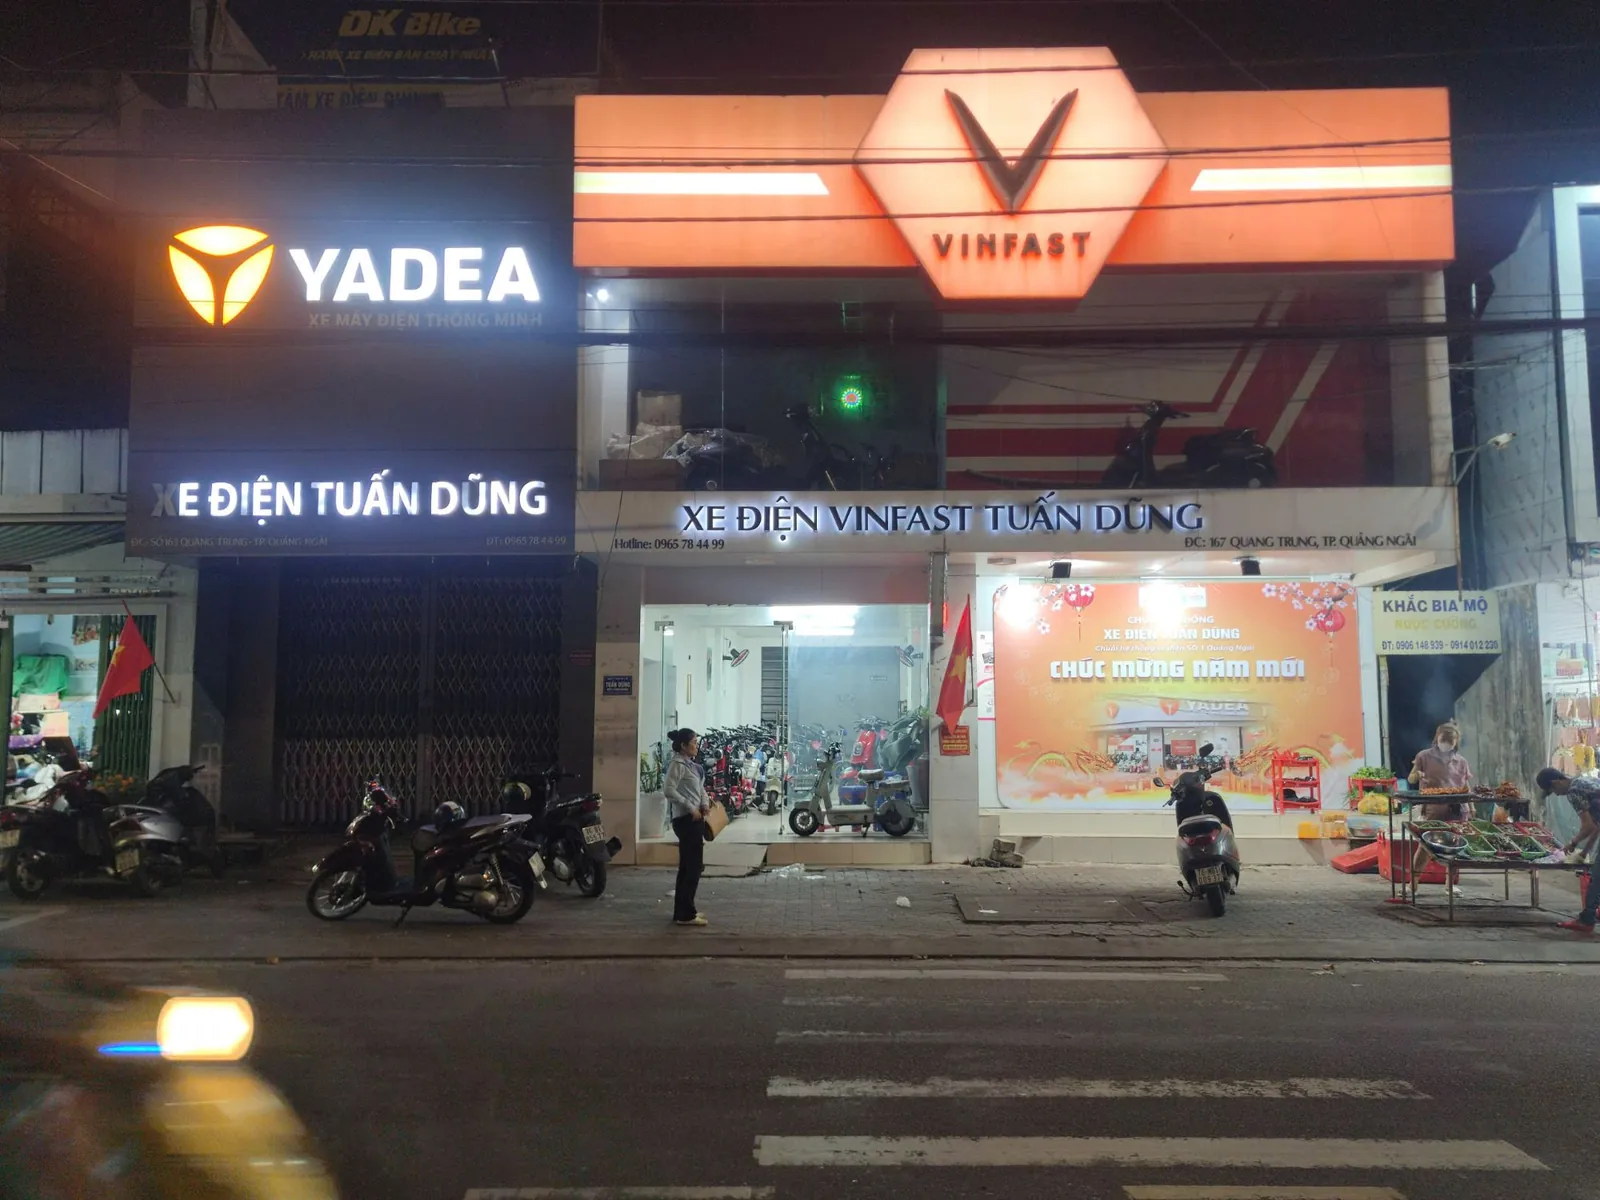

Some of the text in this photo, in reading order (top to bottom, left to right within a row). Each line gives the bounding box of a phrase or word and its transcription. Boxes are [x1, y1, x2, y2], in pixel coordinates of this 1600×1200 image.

[339, 9, 481, 37] DK Bike
[932, 232, 1091, 257] VINFAST
[288, 247, 541, 302] YADEA
[308, 313, 332, 328] XE
[495, 312, 543, 327] MINH
[151, 469, 547, 526] XE ĐIỆN TUẤN DŨNG
[682, 491, 1203, 541] XE ĐIỆN VINFAST TUẤN DŨNG
[614, 538, 725, 550] Hotline: 0965 78 44 99
[1184, 532, 1417, 549] ĐC: 167 QUANG TRUNG, TP. QUẢNG NGÃI
[1383, 594, 1488, 614] KHẮC BIA MỘ
[1103, 628, 1121, 640] XE
[1382, 641, 1394, 650] ĐT:
[1396, 641, 1414, 650] 0906
[1416, 641, 1429, 650] 148
[1430, 641, 1444, 650] 939
[1450, 640, 1469, 650] 0914
[1470, 640, 1484, 650] 012
[1050, 657, 1106, 679] CHÚC
[1187, 699, 1250, 711] YADEA
